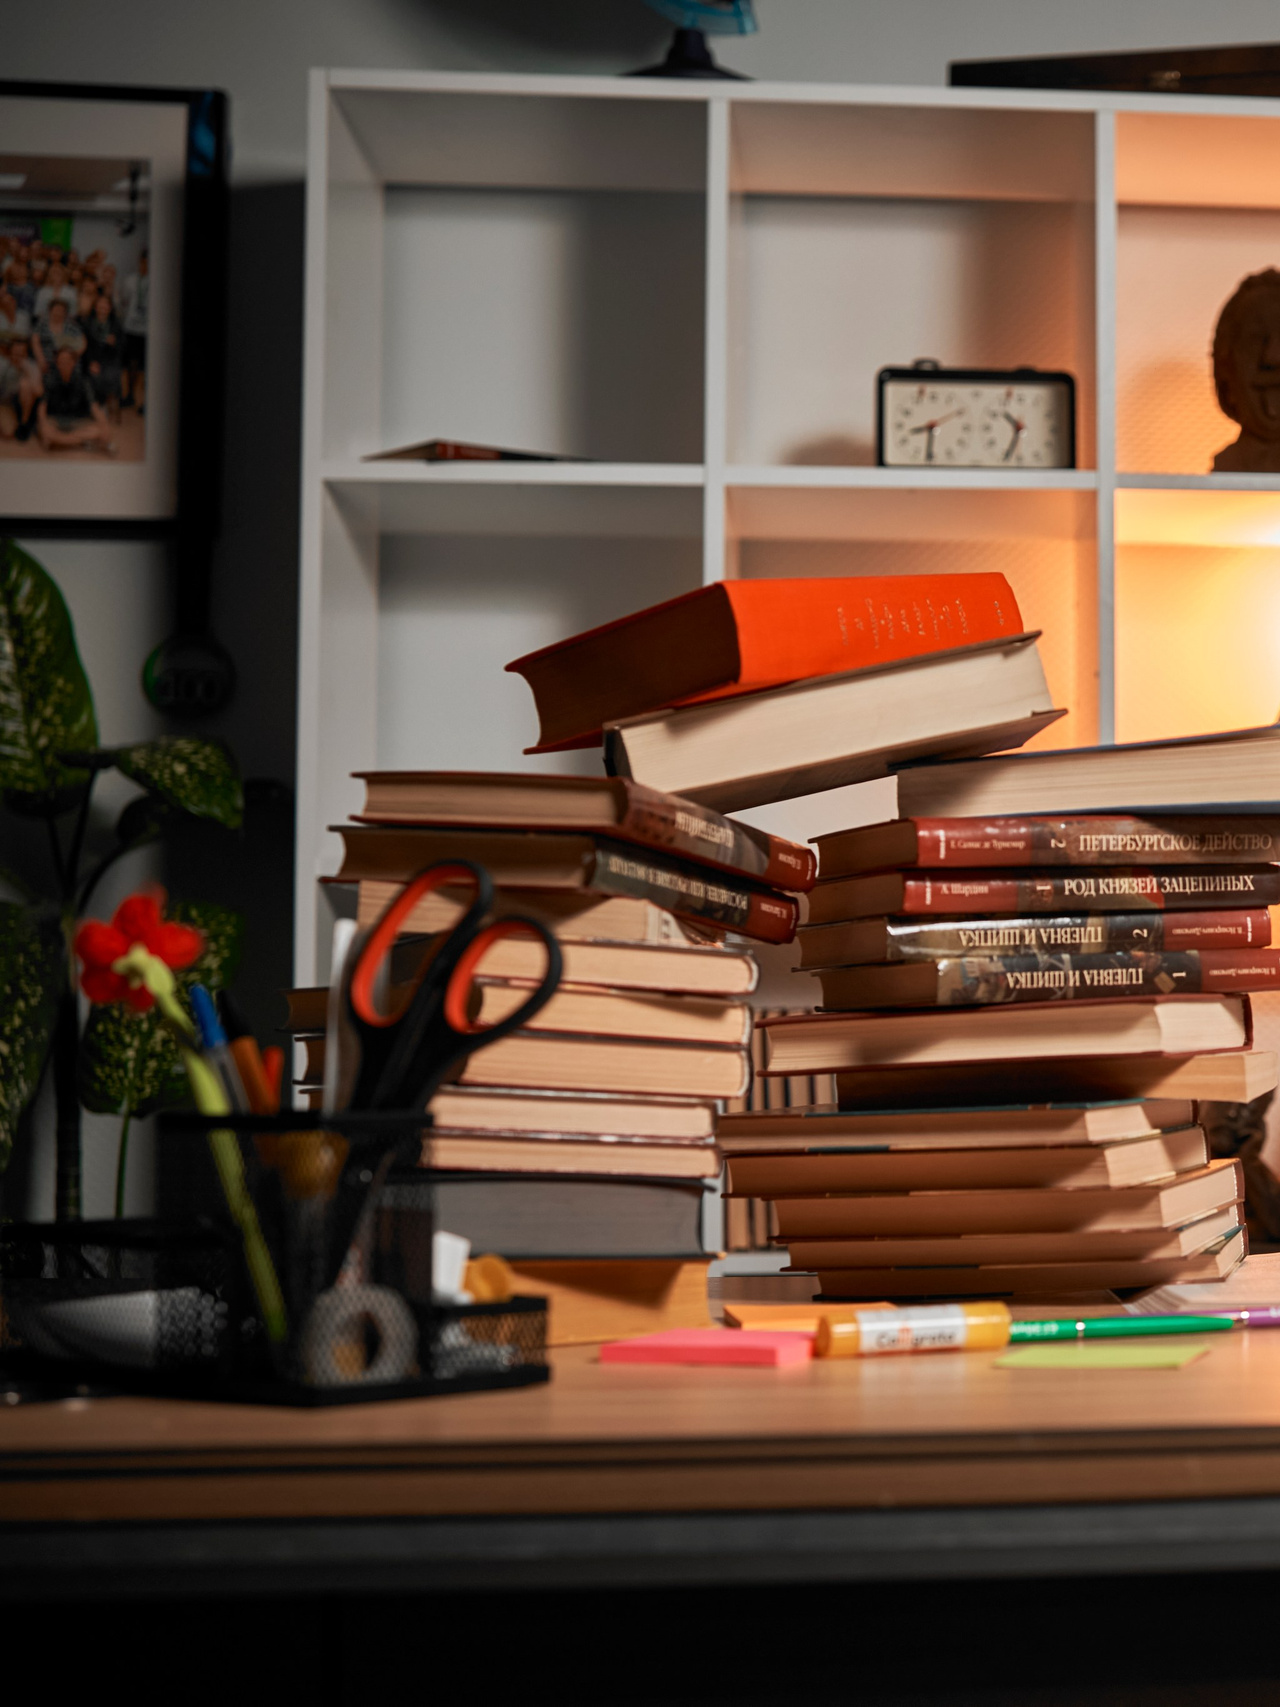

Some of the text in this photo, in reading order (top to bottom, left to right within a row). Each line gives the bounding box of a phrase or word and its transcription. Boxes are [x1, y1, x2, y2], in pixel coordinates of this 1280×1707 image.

[1050, 838, 1067, 849] 2
[1078, 831, 1273, 853] ПЕТЕРБУРГСКОЕ ДЕЙСТВО
[951, 883, 989, 897] Шардин
[1064, 874, 1256, 898] РОД КНЯЗЕЙ ЗАЦЕПИНЫХ
[958, 926, 1103, 947] ПЛЕВНА И ШИПКА
[1132, 928, 1148, 939] 2
[1005, 967, 1144, 989] ПЛЕВНА И ШИПКА
[1172, 971, 1187, 979] 1
